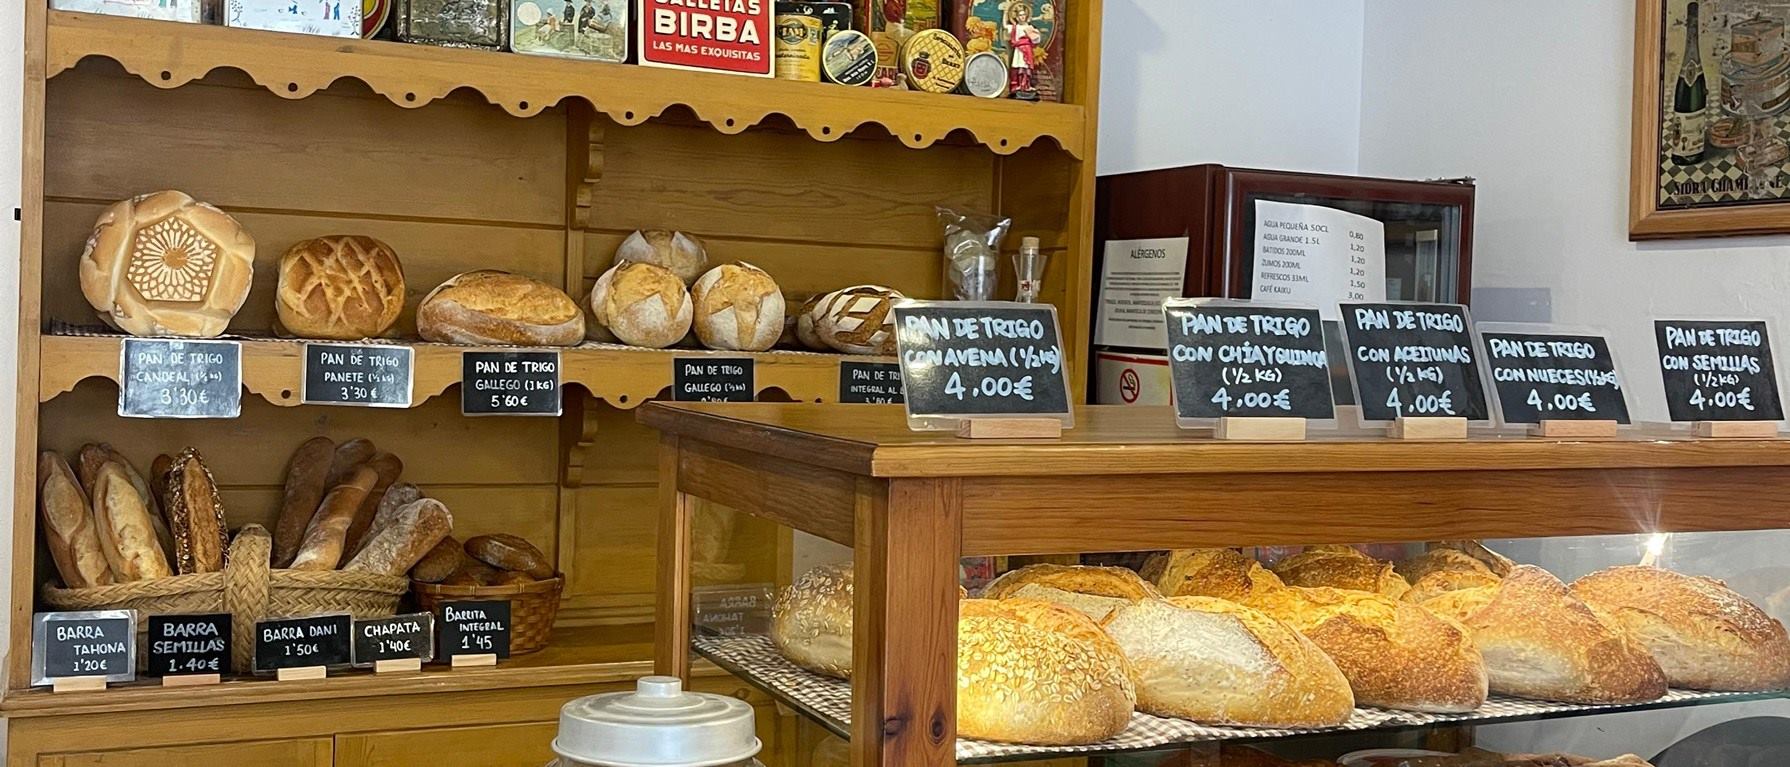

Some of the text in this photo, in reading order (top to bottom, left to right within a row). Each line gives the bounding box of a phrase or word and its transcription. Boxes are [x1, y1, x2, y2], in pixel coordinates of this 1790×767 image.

[654, 8, 760, 45] BIRBA
[653, 40, 761, 61] LAS MAS EXQUISITAS
[1264, 220, 1364, 241] AGUA PEQUEÑA 50CL 0,80
[1264, 233, 1279, 242] AGUA
[1279, 235, 1303, 244] GRANDE
[1350, 244, 1365, 253] 1,20
[1263, 246, 1366, 265] BATIDOS 200ML 1,20
[1262, 259, 1365, 277] ZUMOS 200ML 1,20
[1261, 272, 1291, 281] REFRESCOS
[1350, 280, 1366, 289] 1,50
[1260, 284, 1273, 293] CAFÉ
[1348, 292, 1364, 301] 3,00
[905, 316, 1044, 341] PAN DE TRIGO
[1182, 314, 1223, 336] PAN
[1223, 316, 1247, 334] DE
[1250, 314, 1310, 338] TRIGO
[1355, 308, 1464, 333] PAN DE TRIGO
[1666, 326, 1761, 349] PAN DE TRIGO
[1172, 344, 1213, 362] CON
[1358, 344, 1471, 364] CON ACEITUNAS
[1490, 338, 1596, 359] PAN DE TRIGO
[139, 352, 223, 364] PAN DE TRIGO
[321, 352, 399, 367] PAN DE TRIGO
[904, 350, 942, 368] CON
[944, 348, 1008, 367] AVENA
[1663, 354, 1760, 375] CON SEMILLAS
[476, 362, 555, 374] PAN DE TRIGO
[685, 364, 743, 376] PAN DE TRIGO
[853, 369, 901, 380] PAN DE TRI
[136, 372, 189, 382] CANDEAL
[325, 372, 363, 383] PANETE
[475, 380, 520, 390] GALLEGO
[1494, 368, 1526, 382] CON
[1526, 368, 1586, 386] NUECES
[684, 383, 722, 393] GALLEGO
[850, 385, 885, 394] INTEGRAL
[888, 386, 898, 394] AL
[446, 606, 487, 622] BARRITA
[56, 626, 105, 641] BARRA
[163, 622, 219, 638] BARRA
[264, 624, 337, 643] BARRA DANI
[364, 622, 421, 638] CHAPATA
[460, 621, 505, 632] INTEGRAL
[74, 642, 126, 656] TAHONA
[153, 640, 225, 655] SEMILLAS
